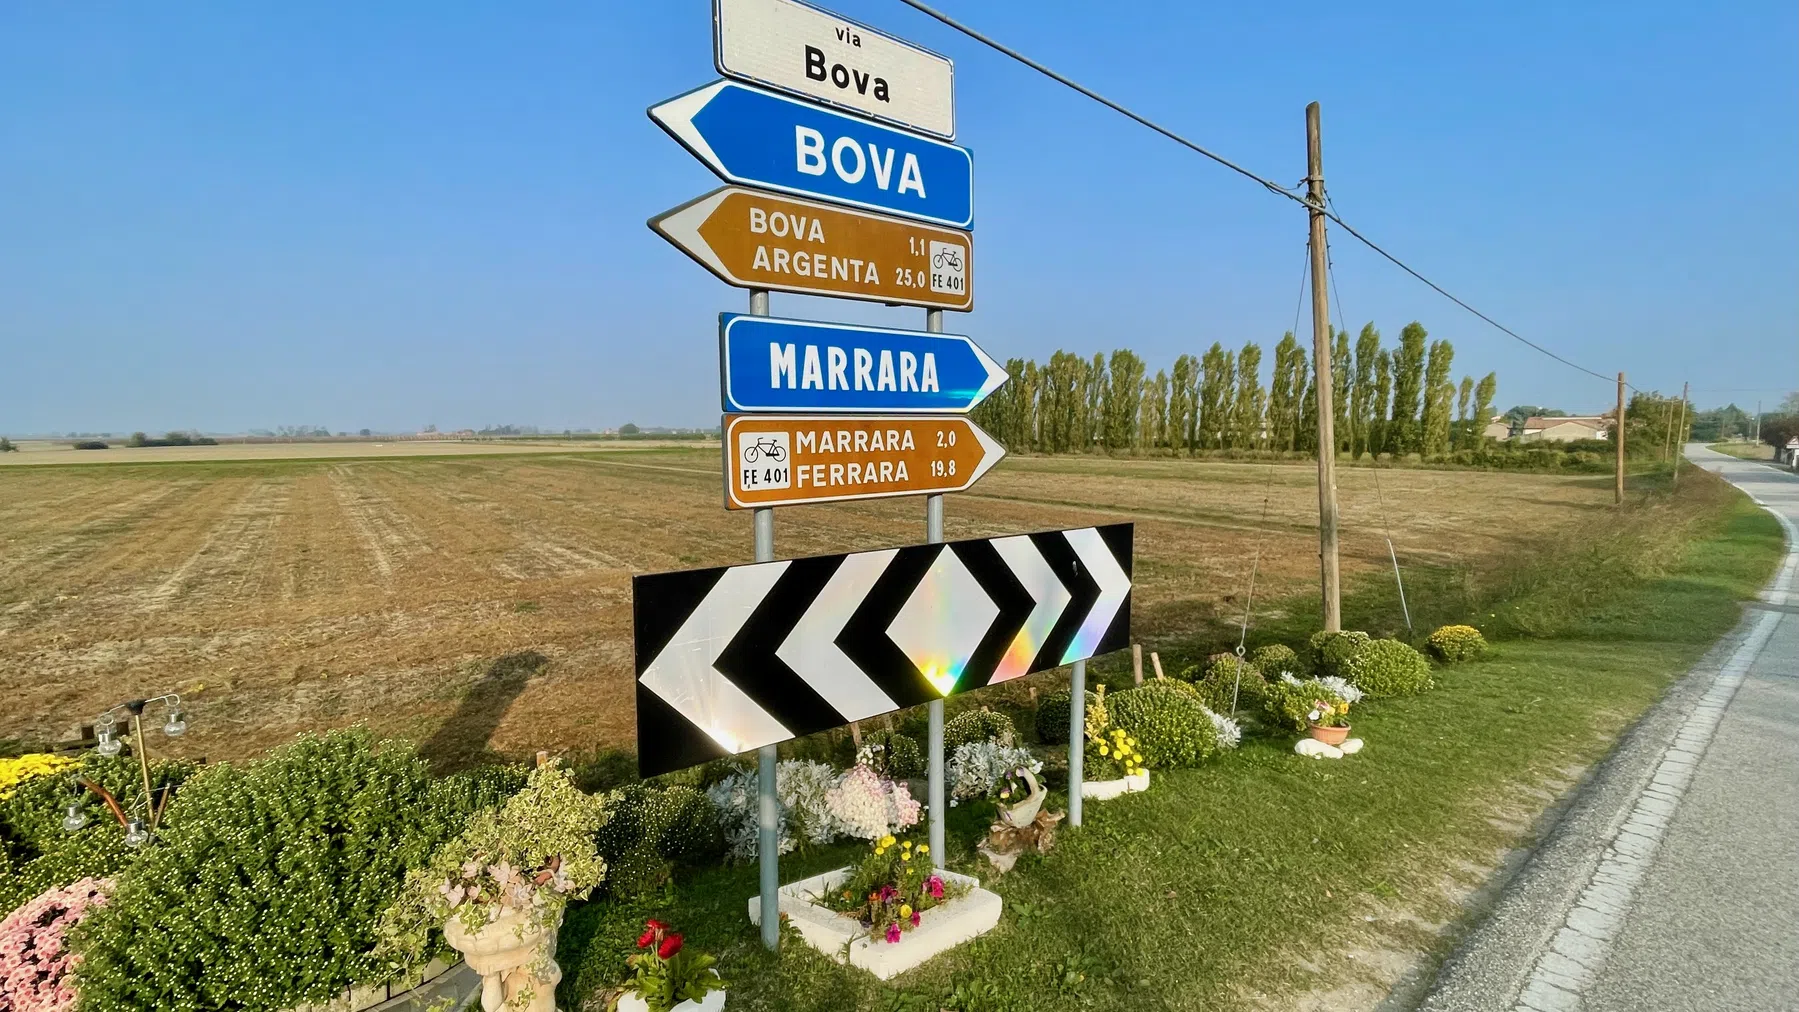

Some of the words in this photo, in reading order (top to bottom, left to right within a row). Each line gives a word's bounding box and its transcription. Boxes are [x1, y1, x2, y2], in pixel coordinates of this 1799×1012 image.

[835, 27, 862, 48] via
[805, 44, 890, 103] Bova
[795, 125, 926, 199] BOVA
[749, 207, 825, 244] BOVA
[909, 236, 925, 256] 1,1
[752, 245, 880, 285] ARGENTA
[895, 267, 926, 288] 25,0
[932, 273, 943, 288] FE
[946, 275, 964, 291] 401
[770, 342, 940, 393] MARRARA
[796, 429, 915, 454] MARRARA
[936, 430, 956, 448] 2,0
[743, 469, 758, 485] FE
[763, 467, 788, 484] 401
[797, 460, 909, 488] FERRARA
[930, 460, 956, 477] 19,8
